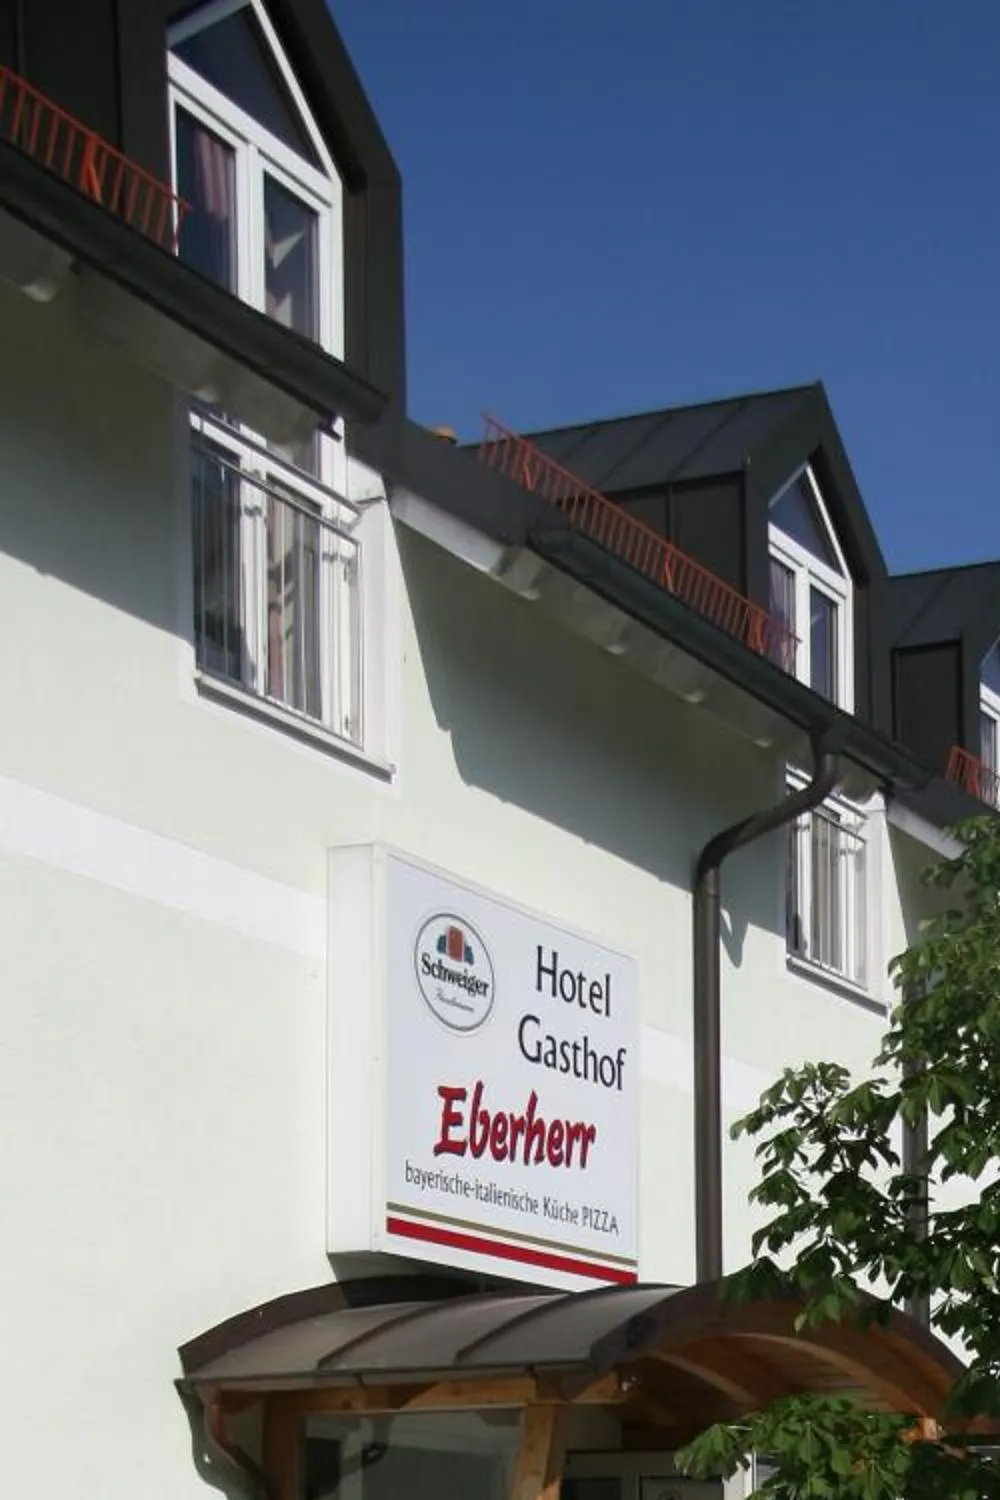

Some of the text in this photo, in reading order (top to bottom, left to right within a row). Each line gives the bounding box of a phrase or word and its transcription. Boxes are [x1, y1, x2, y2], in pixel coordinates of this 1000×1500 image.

[421, 951, 490, 998] Schweiger
[536, 945, 611, 1018] Hotel
[518, 1015, 627, 1091] Gasthof
[433, 1081, 597, 1170] Eberherr
[404, 1161, 619, 1236] bayerische-italienische Küche PIZZA
